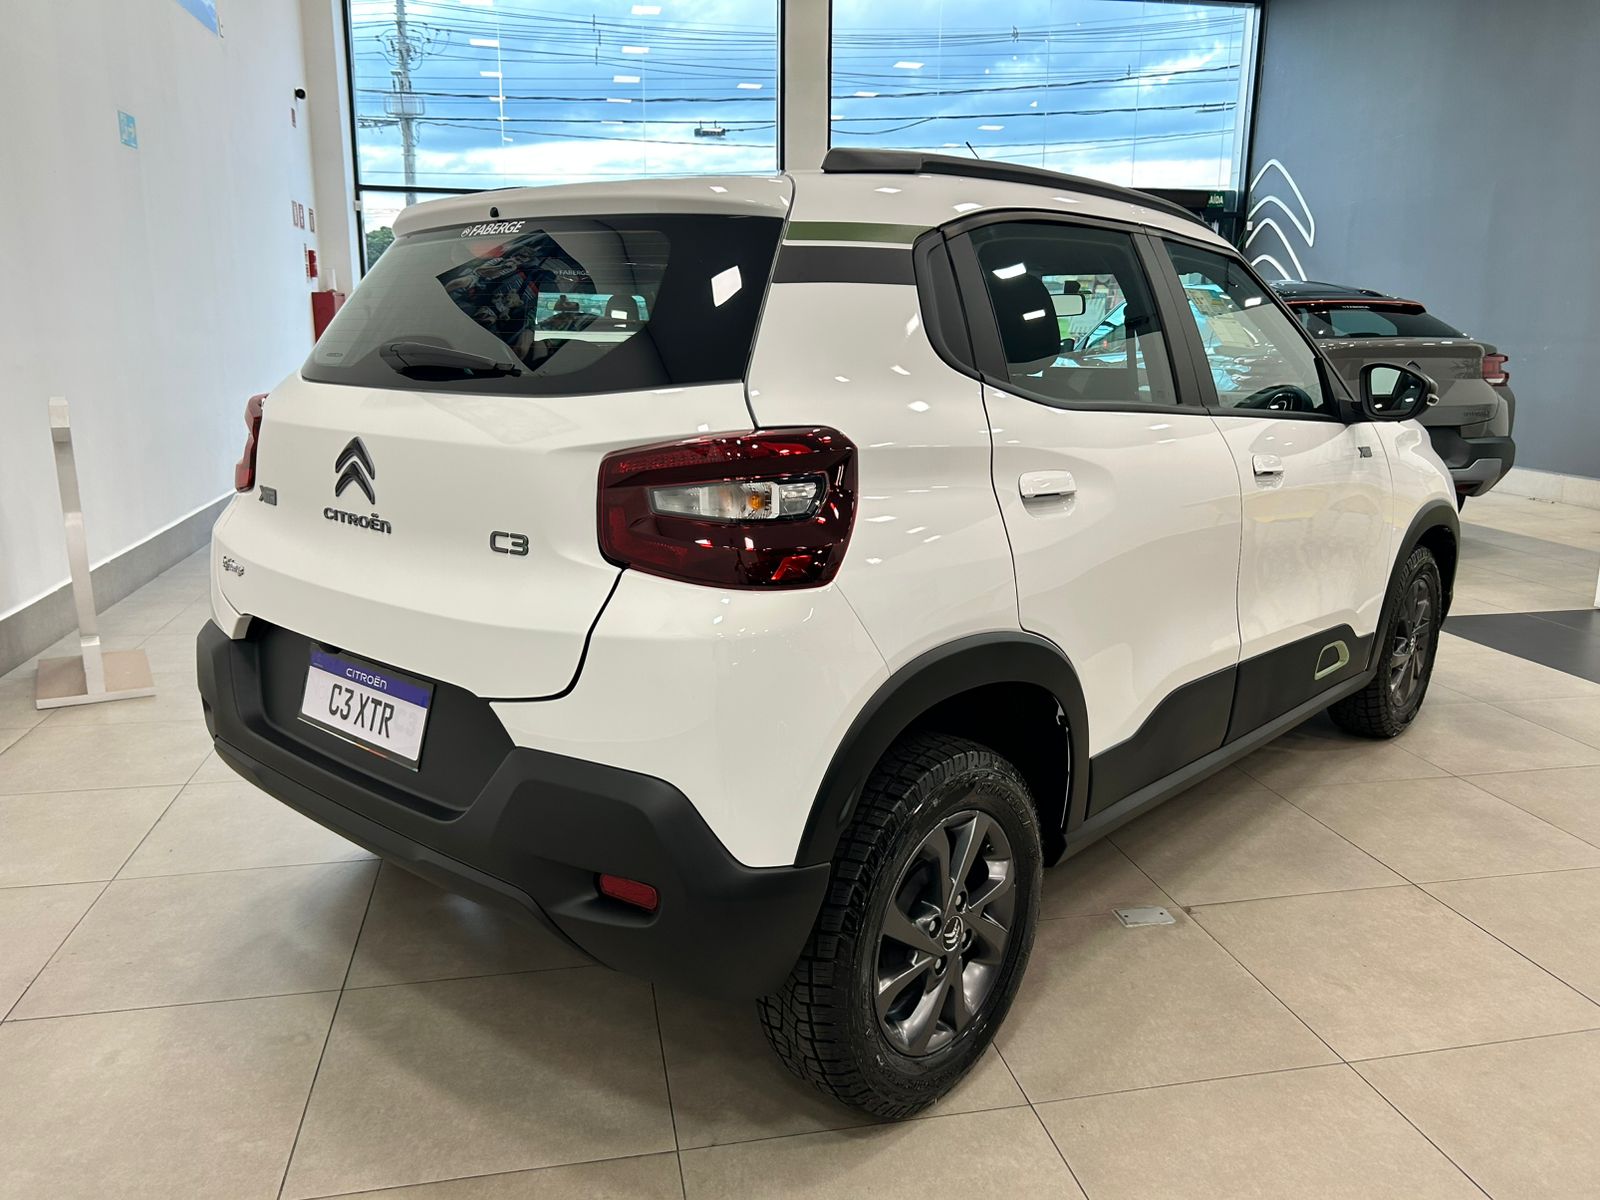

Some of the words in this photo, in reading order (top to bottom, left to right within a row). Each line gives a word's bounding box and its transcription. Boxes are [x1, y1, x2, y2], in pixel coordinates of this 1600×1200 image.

[468, 221, 526, 236] FABERGE
[489, 530, 529, 556] C3
[328, 683, 355, 721] C3
[353, 692, 395, 739] XTR
